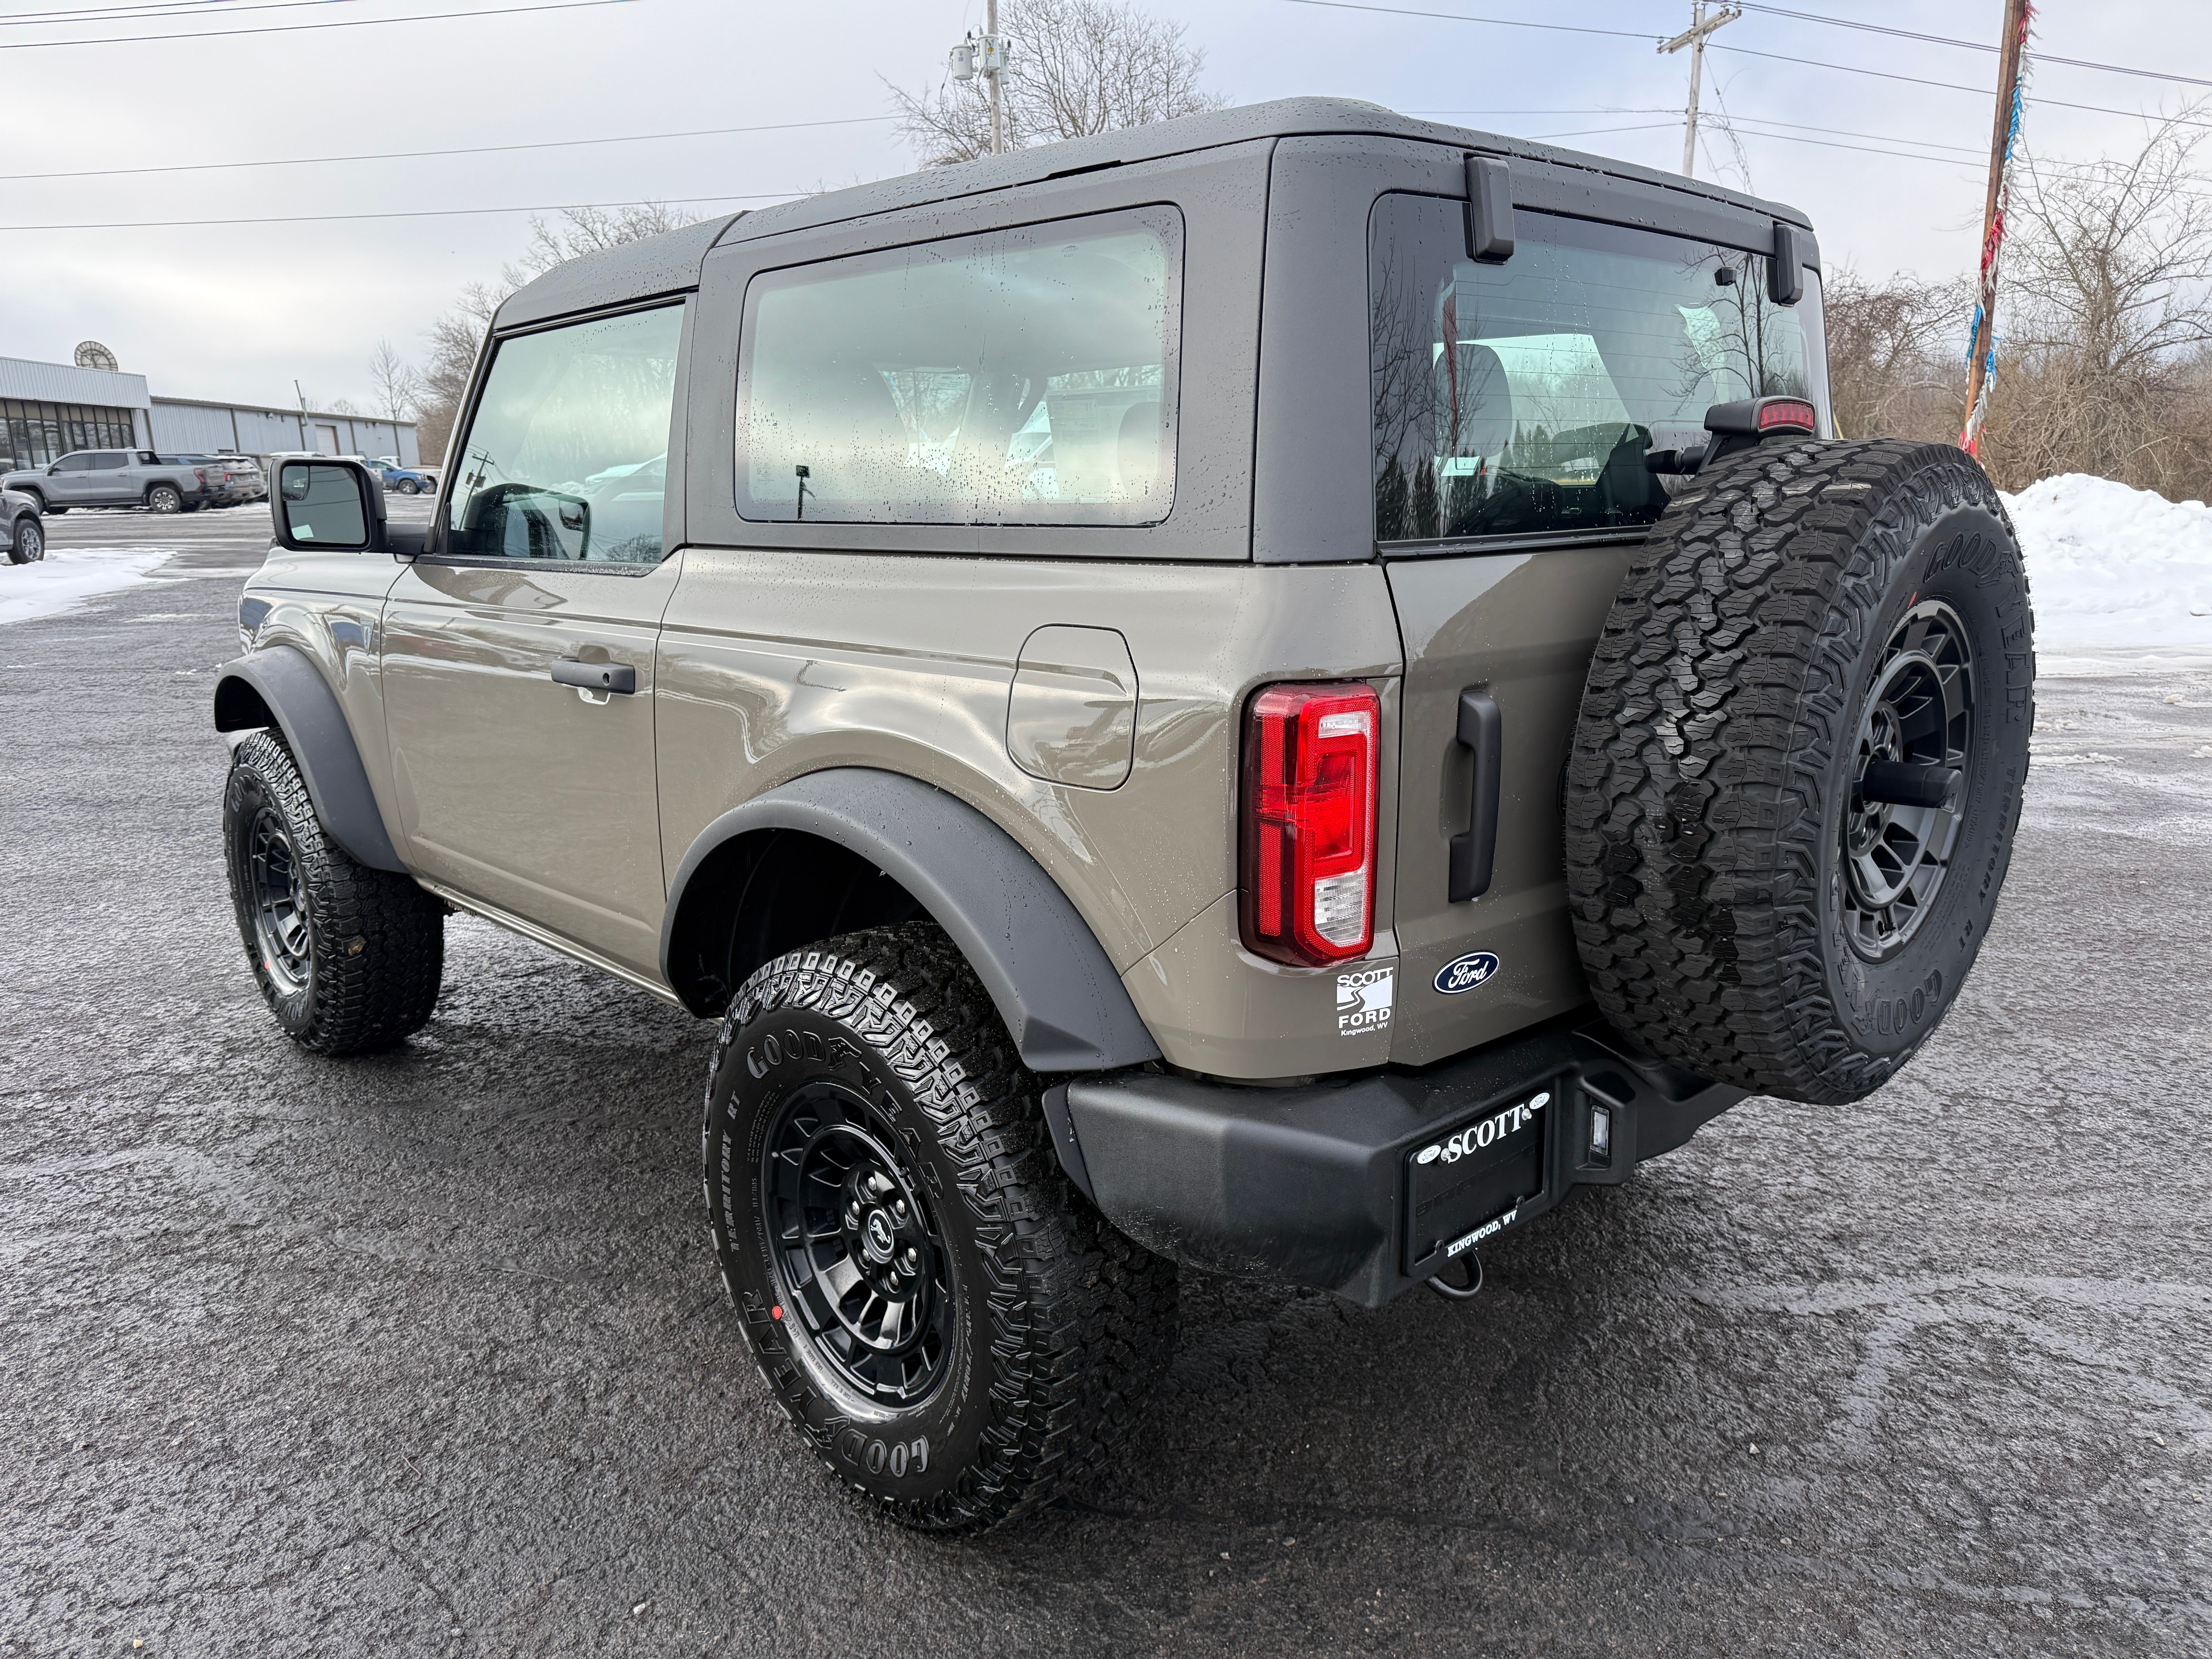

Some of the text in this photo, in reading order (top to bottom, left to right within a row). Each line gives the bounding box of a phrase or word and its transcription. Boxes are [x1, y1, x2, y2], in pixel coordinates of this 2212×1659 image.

[1958, 766, 2017, 953] TERRITORY RT
[1336, 967, 1394, 988] SCOTT
[1448, 958, 1489, 989] Ford
[1338, 1008, 1391, 1029] FORD
[1341, 1021, 1388, 1037] Kingwood, WV
[746, 1029, 944, 1200] GOODYEAR
[1447, 1103, 1525, 1164] SCOTT
[721, 1090, 741, 1252] TERRITORY RT
[1422, 1149, 1436, 1161] Ford
[1447, 1209, 1517, 1257] KINGWOOD, WV
